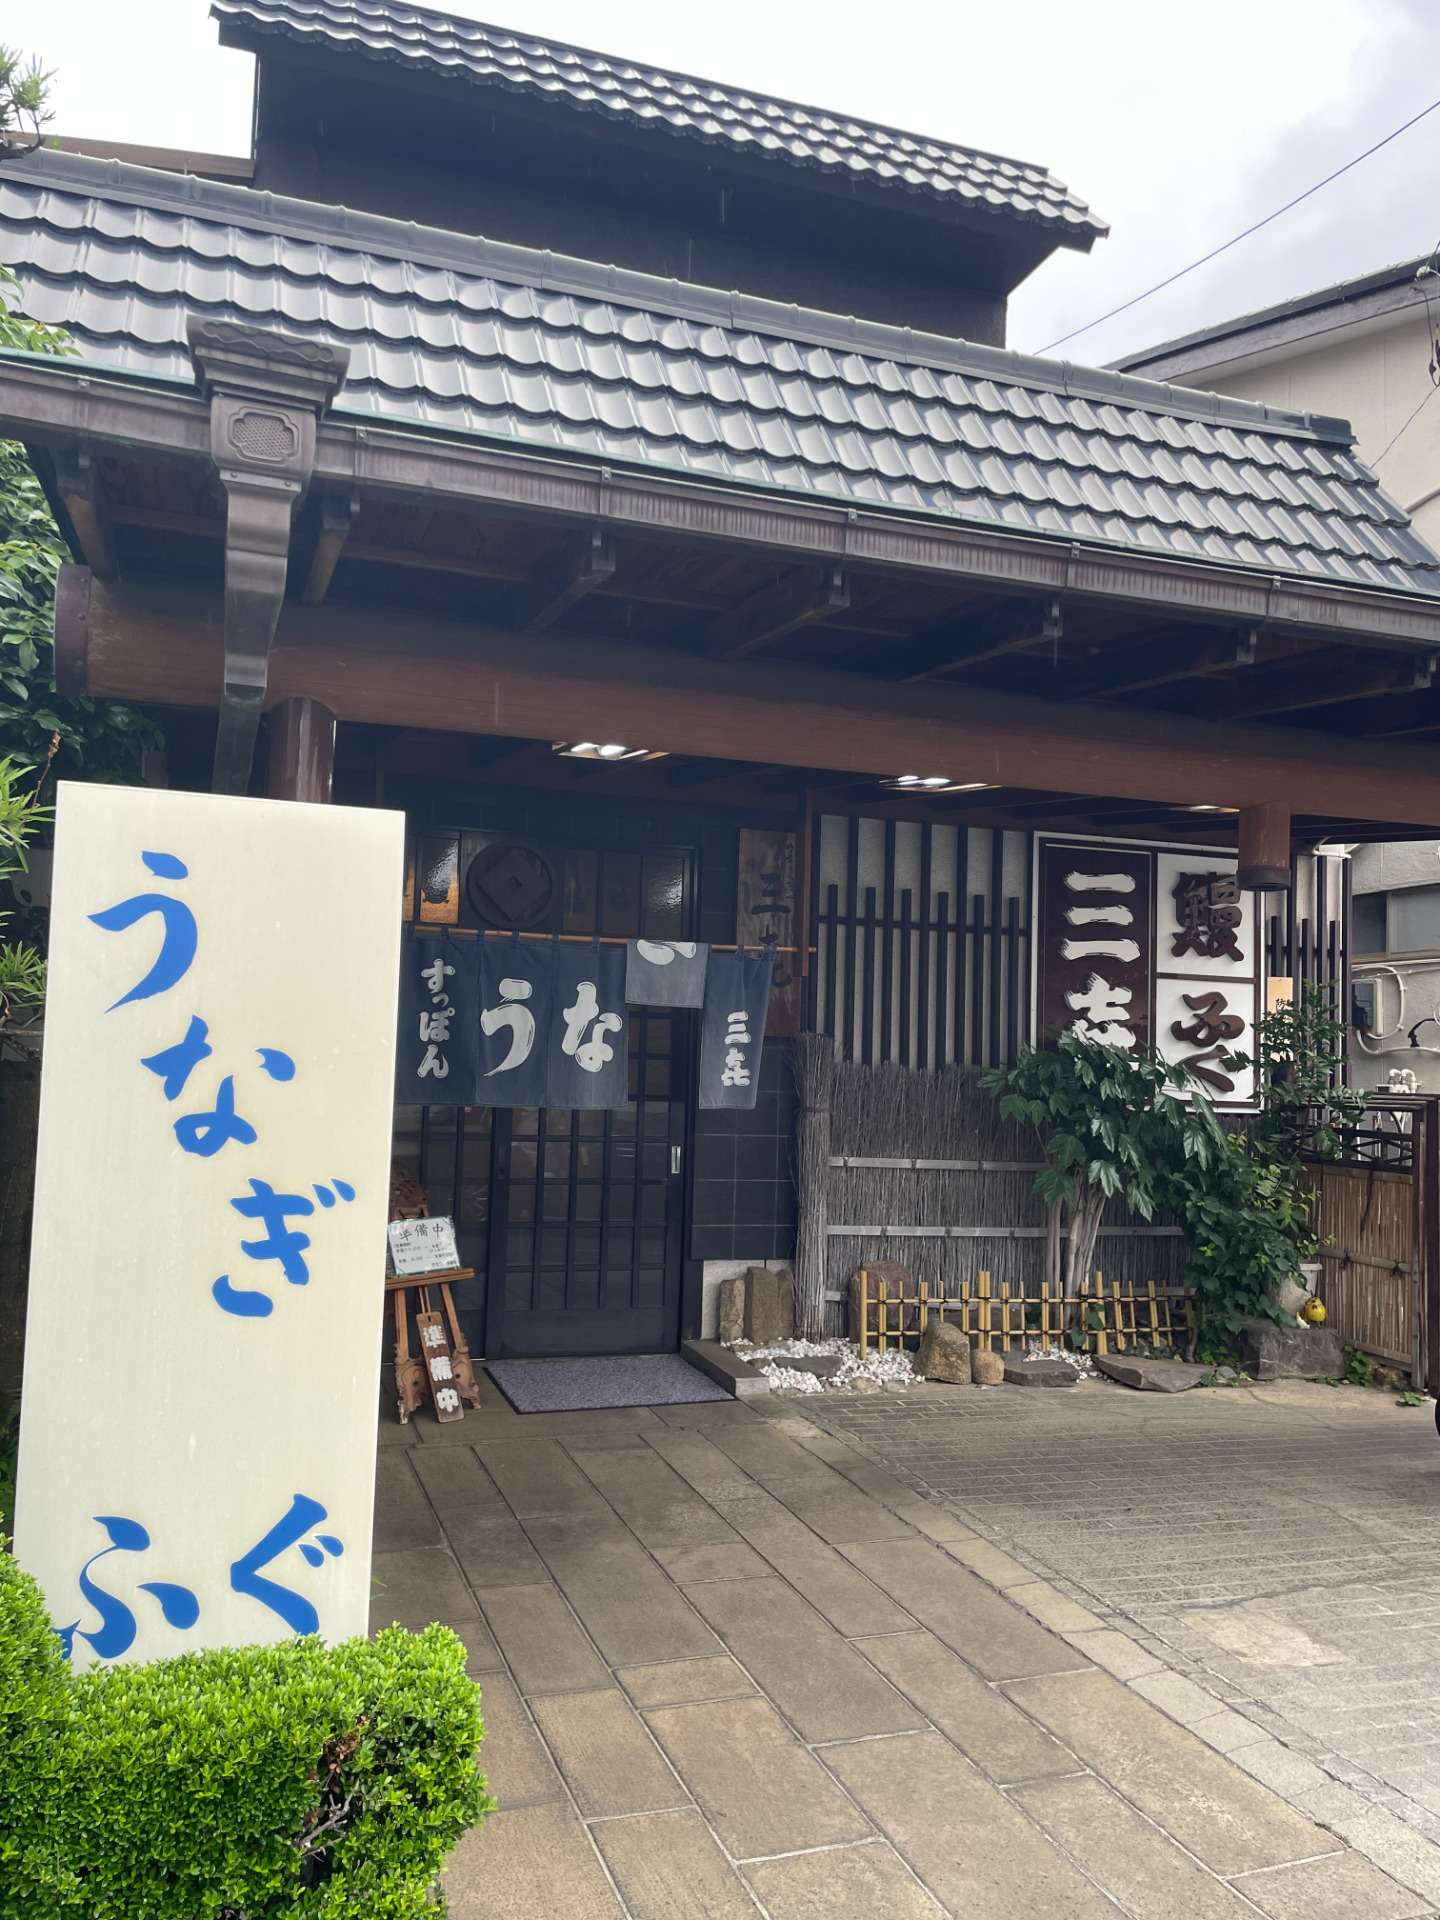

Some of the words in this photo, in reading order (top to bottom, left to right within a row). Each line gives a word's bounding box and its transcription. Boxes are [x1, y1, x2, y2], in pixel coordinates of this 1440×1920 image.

[87, 850, 356, 1317] うなぎ
[417, 958, 456, 1079] すっぽん
[51, 1492, 345, 1660] ふぐ
